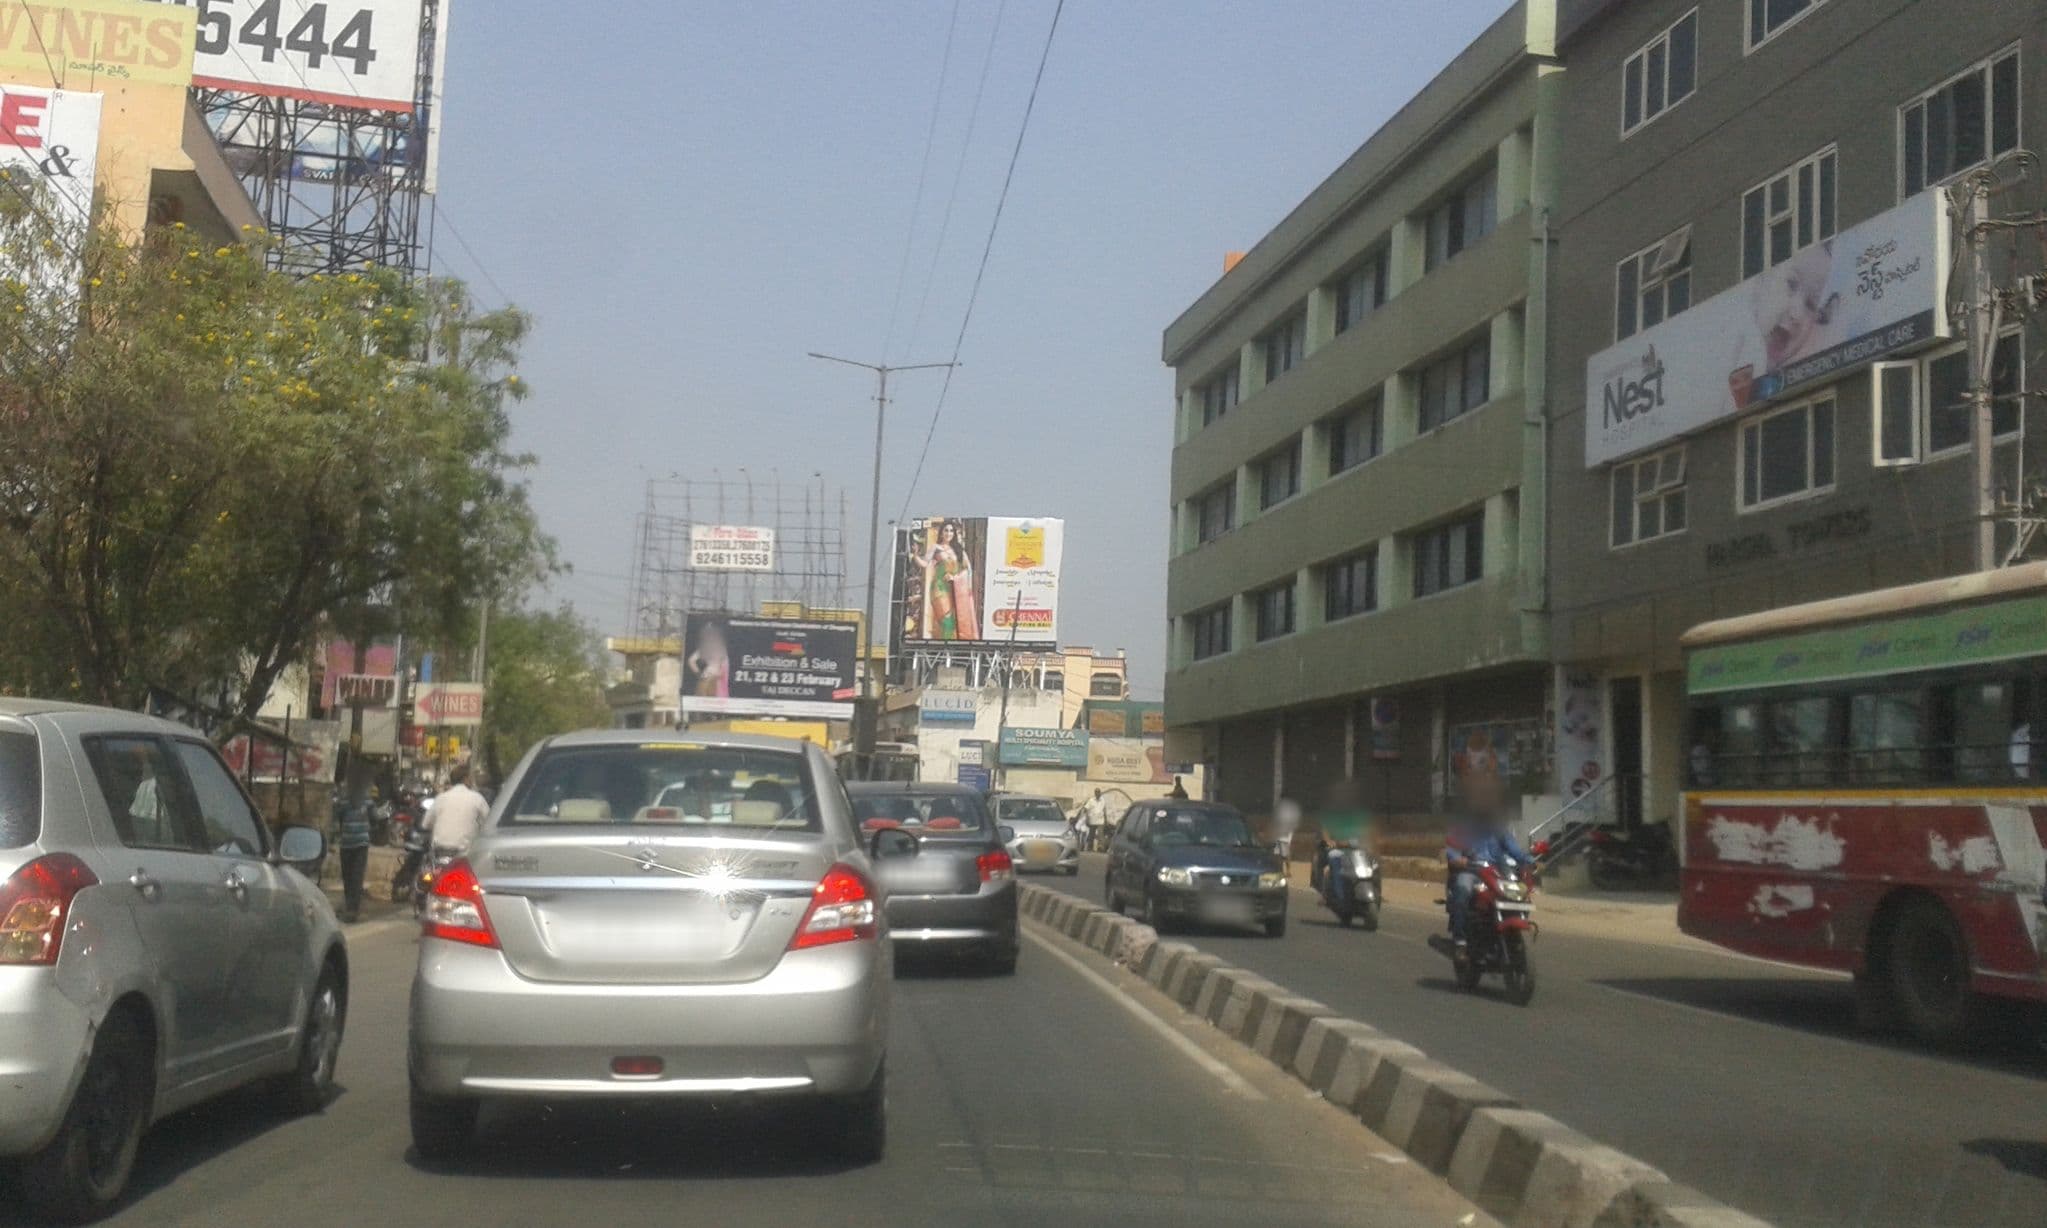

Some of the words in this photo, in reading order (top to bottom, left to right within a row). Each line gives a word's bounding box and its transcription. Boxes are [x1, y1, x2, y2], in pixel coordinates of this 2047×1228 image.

[40, 145, 80, 178] &
[1604, 360, 1665, 429] Nest
[743, 655, 798, 668] Exhibition
[800, 657, 808, 669] &
[811, 658, 837, 670] Sale
[797, 673, 842, 688] February
[431, 695, 478, 713] WINES
[1015, 728, 1075, 739] SOUMYA
